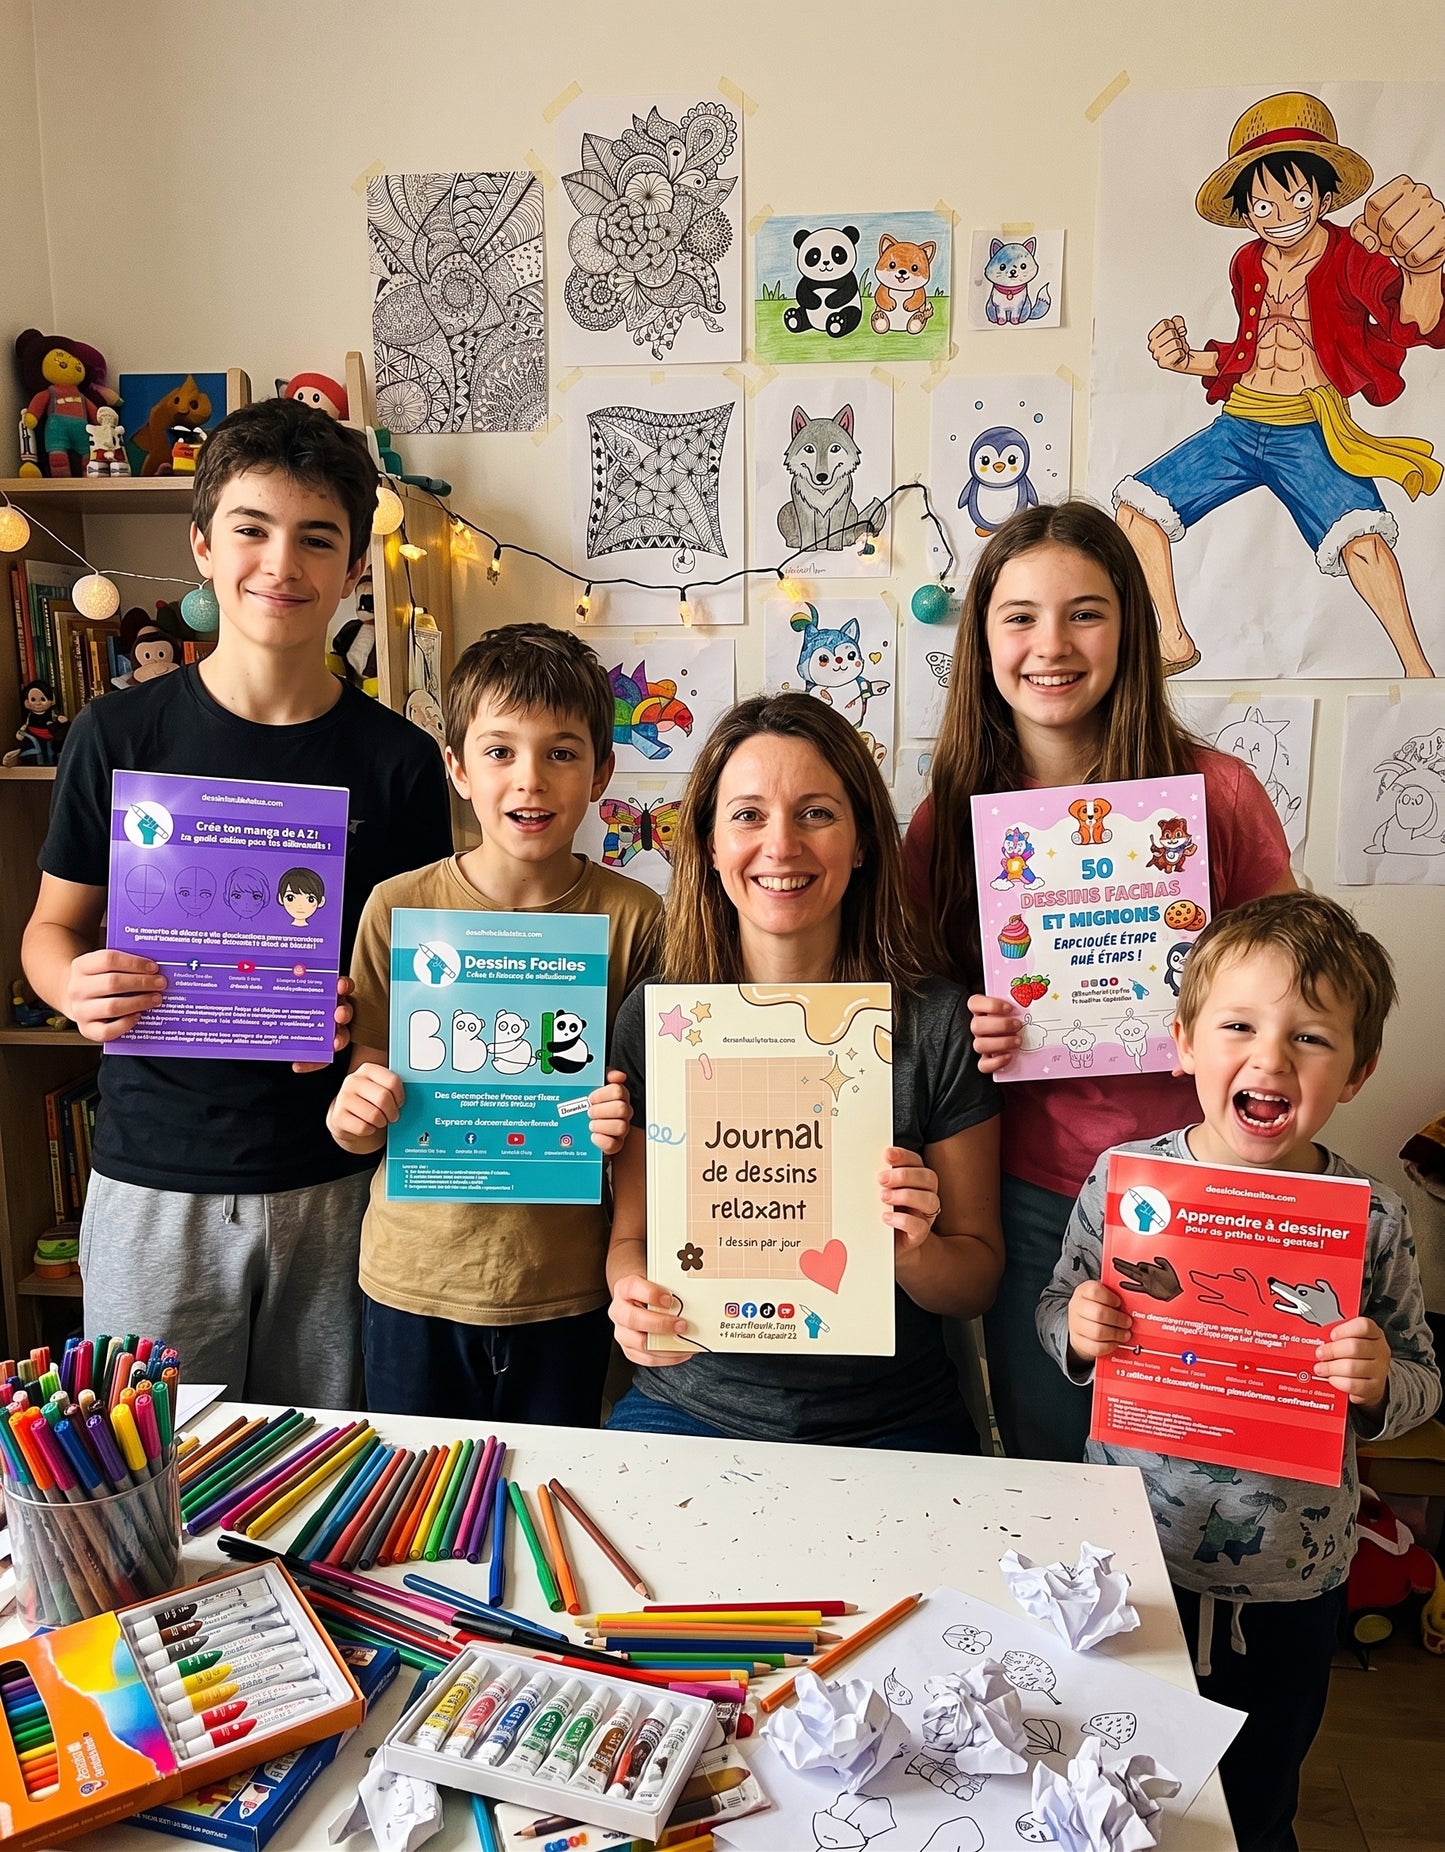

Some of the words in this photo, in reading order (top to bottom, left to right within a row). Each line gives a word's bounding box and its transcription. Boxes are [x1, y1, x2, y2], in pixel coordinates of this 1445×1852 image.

[223, 823, 242, 834] ton
[244, 826, 280, 840] manga
[282, 828, 295, 838] de
[296, 830, 306, 839] A
[1082, 858, 1114, 880] 50
[1020, 886, 1100, 909] DESSINS
[1104, 880, 1181, 902] FACHAS
[1042, 914, 1066, 930] ET
[1070, 906, 1160, 928] MIGNONS
[464, 956, 526, 970] Dessins
[704, 1120, 823, 1150] Journal
[702, 1160, 728, 1182] de
[736, 1160, 817, 1184] dessins
[712, 1198, 806, 1220] relaxant
[1176, 1208, 1262, 1230] Apprendre
[1265, 1218, 1275, 1231] à
[1278, 1220, 1350, 1240] dessiner
[1185, 1225, 1208, 1234] pour
[719, 1236, 723, 1246] 1
[726, 1236, 758, 1247] dessin
[760, 1238, 777, 1252] par
[779, 1237, 801, 1252] jour
